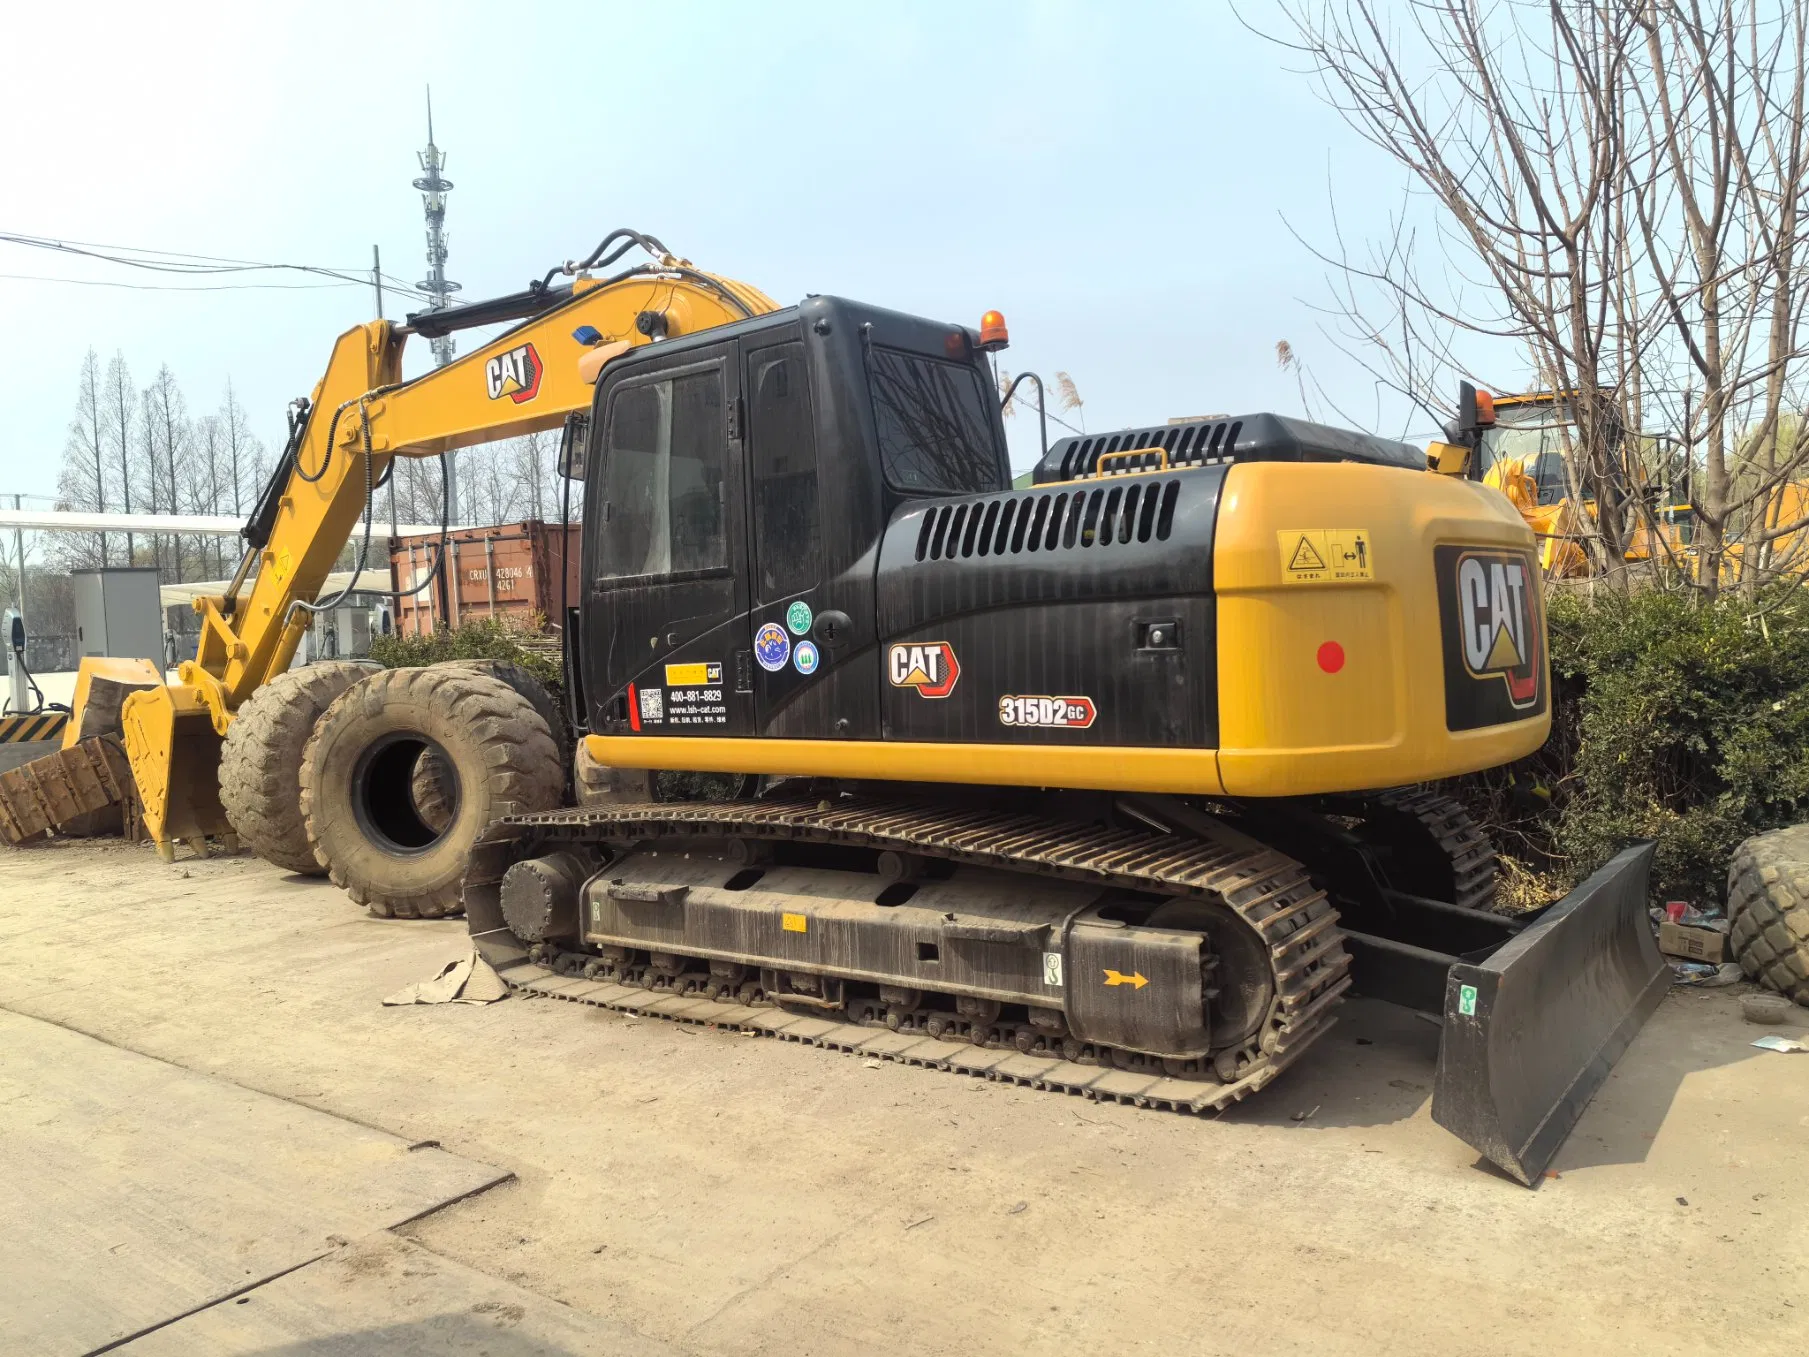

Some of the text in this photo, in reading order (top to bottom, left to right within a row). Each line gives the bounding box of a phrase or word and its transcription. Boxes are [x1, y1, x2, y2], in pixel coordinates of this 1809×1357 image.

[486, 346, 527, 399] CAT
[496, 568, 523, 579] 428046
[1460, 559, 1526, 670] CAT
[890, 646, 941, 684] CAT
[707, 667, 720, 678] CAT
[671, 690, 722, 702] 400-881-8829
[669, 705, 726, 714] www.lsh-cat.com
